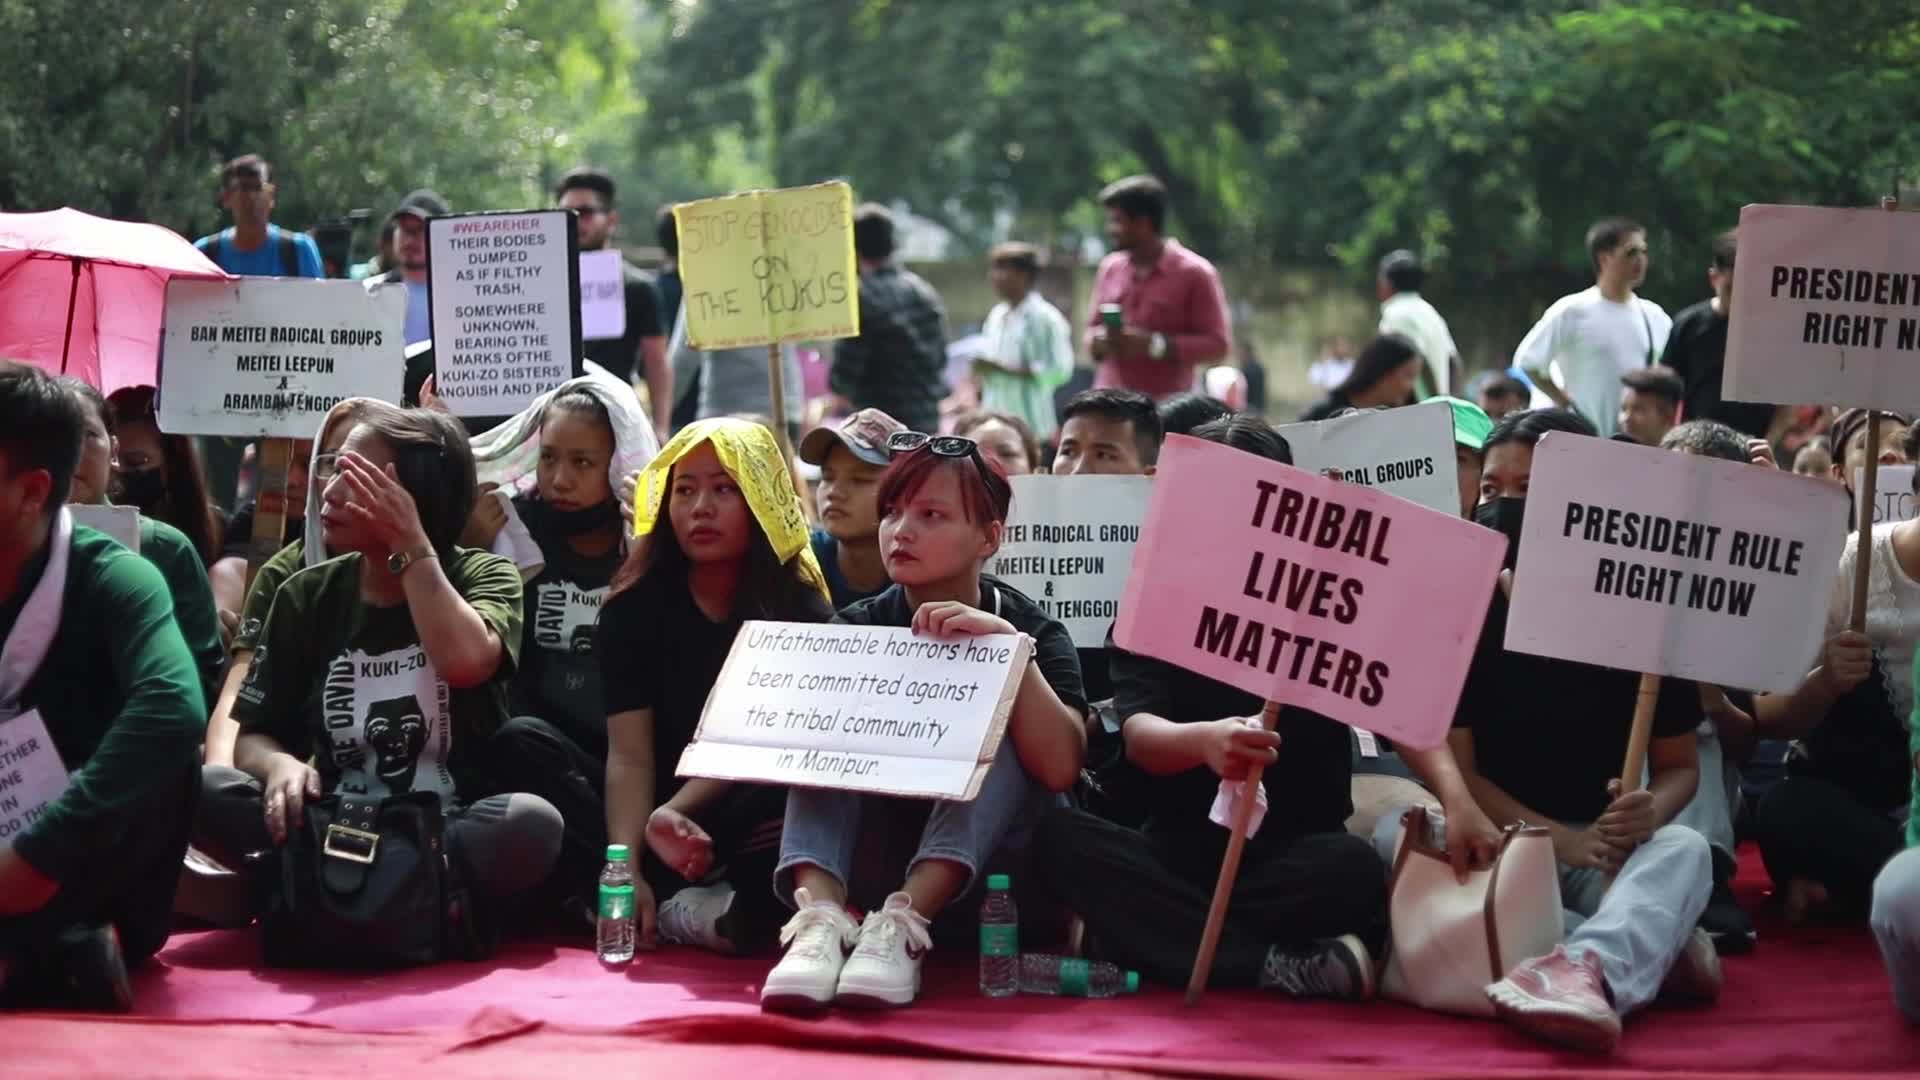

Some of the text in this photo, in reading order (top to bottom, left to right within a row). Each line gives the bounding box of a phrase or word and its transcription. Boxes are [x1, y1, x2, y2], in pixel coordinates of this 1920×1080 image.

[453, 218, 540, 234] #WEAREHER
[684, 209, 739, 254] STOP
[449, 234, 547, 250] THEIR BODIES
[468, 250, 528, 264] DUMPED
[752, 249, 789, 280] ON
[455, 266, 543, 282] AS IF FILTHY
[692, 271, 849, 320] THE KUKIS
[455, 302, 546, 319] SOMEWHERE
[191, 326, 382, 346] BAN MEITEI RADICAL GROUPS
[455, 334, 549, 350] BEARING THE
[1803, 312, 1920, 351] RIGHT N
[236, 355, 334, 373] MEITEI LEEPUN
[452, 352, 502, 366] MARKS
[276, 376, 288, 390] &
[442, 365, 565, 382] KUKI-ZO SISTERS'
[438, 382, 561, 399] ANGUISH AND PA
[290, 393, 346, 412] TENGG
[1341, 457, 1434, 486] CAL GROUPS
[1032, 524, 1094, 544] RADICAL
[1099, 524, 1140, 543] GROU
[1251, 479, 1392, 567] TRIBAL
[1563, 501, 1805, 576] PRESIDENT RULE
[995, 556, 1104, 576] MEITEI LEEPUN
[1044, 581, 1054, 597] &
[1243, 551, 1364, 625] LIVES
[1594, 557, 1756, 617] RIGHT NOW
[536, 589, 567, 643] DAVID
[748, 628, 1010, 665] Unfathomable horrors have
[1193, 605, 1390, 707] MATTERS
[361, 652, 426, 678] KUKI-ZO
[326, 661, 354, 729] DAVID
[747, 666, 979, 704] been committed against
[745, 704, 949, 747] the tribal community
[776, 749, 880, 779] in Manipur.
[0, 795, 19, 814] IN
